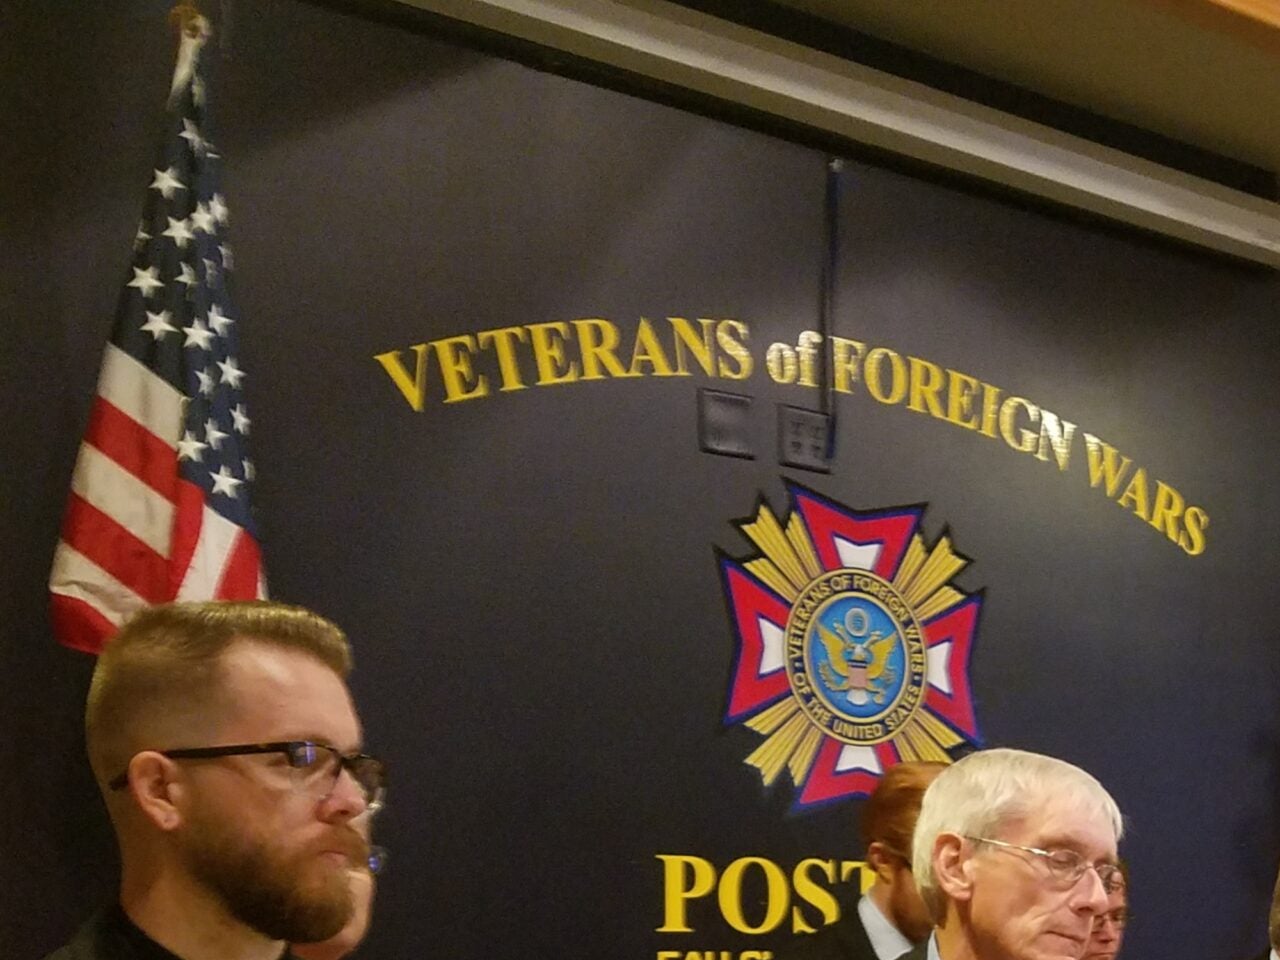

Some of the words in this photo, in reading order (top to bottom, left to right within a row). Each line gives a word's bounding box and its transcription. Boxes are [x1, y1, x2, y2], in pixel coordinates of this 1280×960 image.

[374, 317, 752, 412] VETERANS
[766, 331, 820, 386] of
[830, 336, 1077, 471] FOREIGN
[1083, 433, 1210, 556] WARS
[789, 582, 832, 659] VETERANS
[831, 575, 852, 591] OF
[854, 576, 910, 622] FOREIGN
[904, 623, 925, 676] WARS
[806, 695, 833, 727] THE
[832, 720, 883, 739] UNITED
[885, 685, 921, 731] STATES
